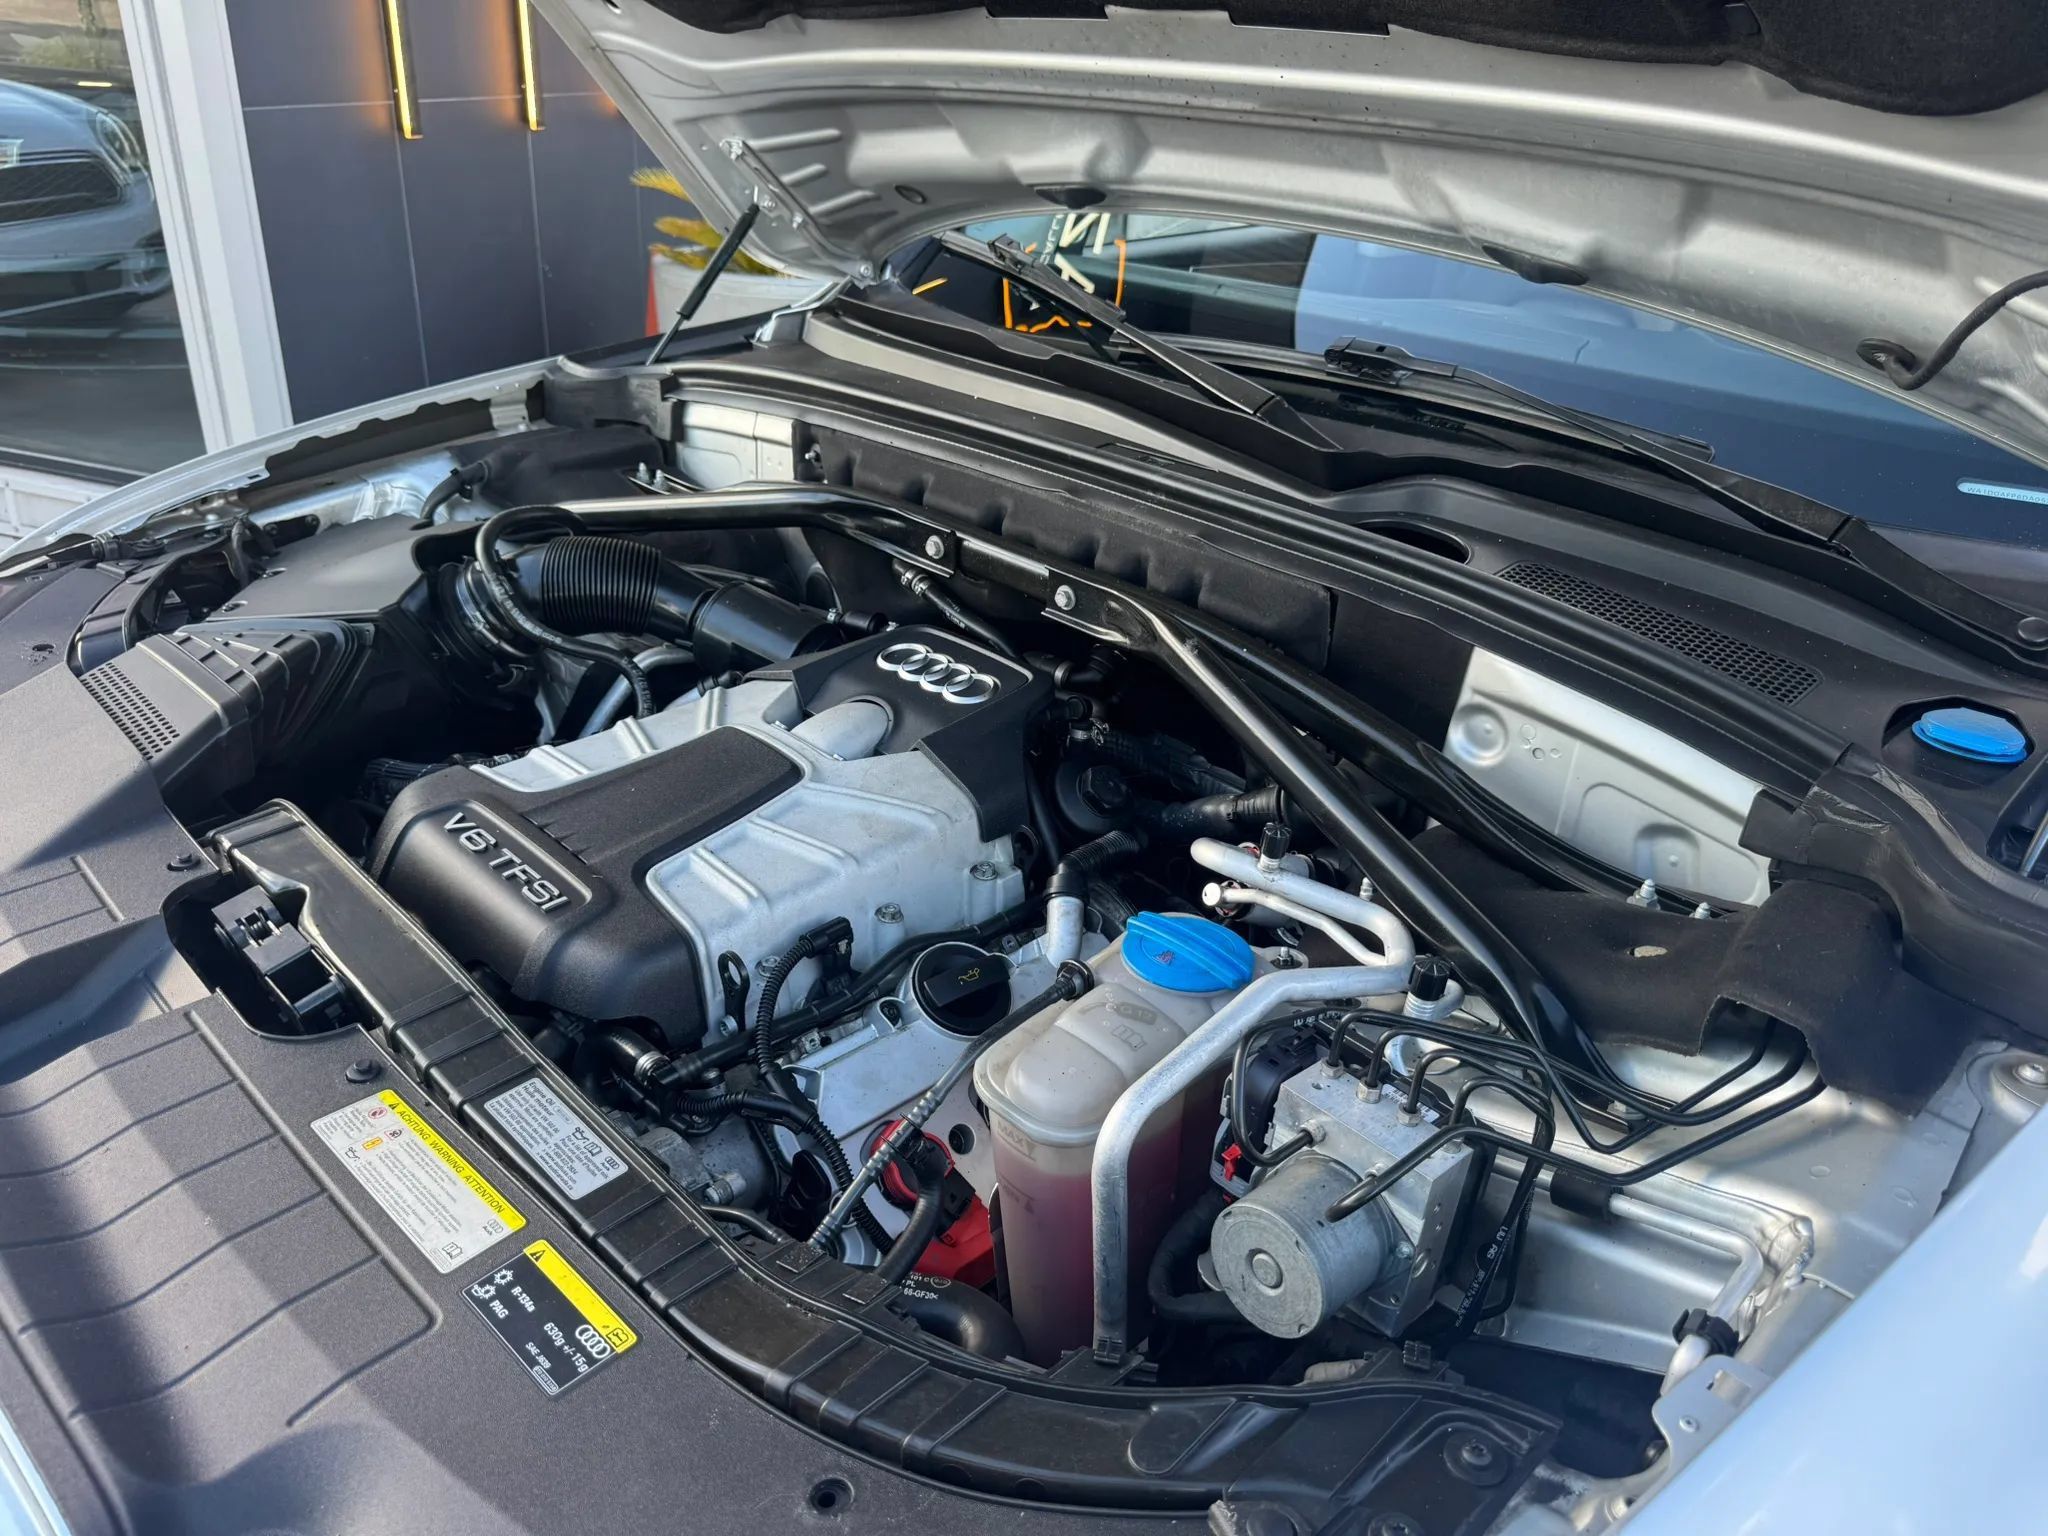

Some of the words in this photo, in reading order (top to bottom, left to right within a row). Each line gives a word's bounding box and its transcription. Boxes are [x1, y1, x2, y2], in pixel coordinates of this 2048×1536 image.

[444, 812, 497, 852] V6
[489, 848, 568, 911] TFSI
[521, 1084, 537, 1098] Huile
[533, 1097, 555, 1117] moteur
[527, 1081, 549, 1099] Engine
[544, 1097, 555, 1106] Oil
[395, 1109, 431, 1140] ACHTUNG
[428, 1140, 465, 1173] WARNING
[463, 1174, 505, 1213] ATTENTION
[488, 1299, 509, 1318] PAG
[525, 1341, 540, 1355] SAE
[510, 1285, 537, 1312] R-134a
[540, 1321, 567, 1346] 630g
